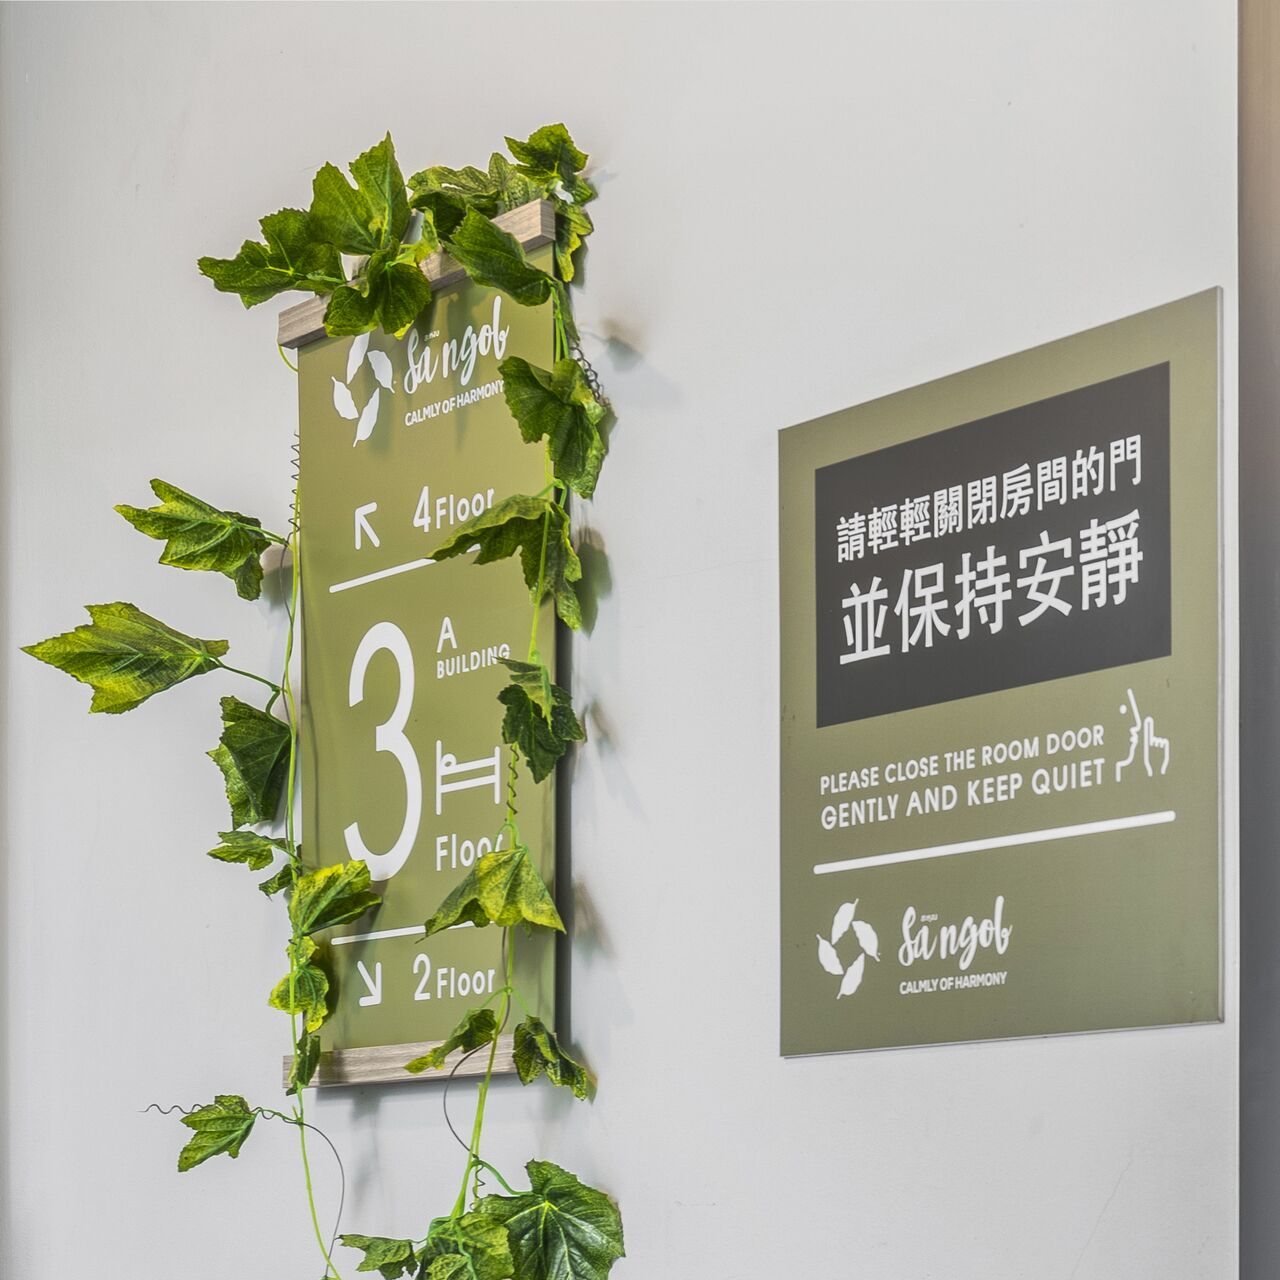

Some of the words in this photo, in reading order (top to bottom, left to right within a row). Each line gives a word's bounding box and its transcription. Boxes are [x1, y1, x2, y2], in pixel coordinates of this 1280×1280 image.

[404, 402, 441, 426] CALMLY
[441, 397, 456, 414] OF
[456, 380, 505, 408] HARMONY
[836, 434, 1142, 563] 請輕輕關閉房間的門
[838, 508, 1144, 665] 並保持安靜
[436, 616, 458, 653] A
[436, 643, 510, 679] BUILDING
[343, 621, 423, 882] 3
[820, 766, 879, 796] PLEASE
[884, 755, 939, 785] CLOSE
[944, 747, 975, 773] THE
[981, 736, 1040, 767] ROOM
[1046, 724, 1105, 756] DOOR
[821, 794, 899, 831] GENTLY
[906, 784, 958, 818] AND
[967, 772, 1023, 807] KEEP
[1031, 757, 1105, 797] QUIET
[437, 968, 496, 999] Floor
[899, 979, 938, 995] CALMLY
[939, 977, 954, 991] OF
[954, 971, 1008, 989] HARMONY
